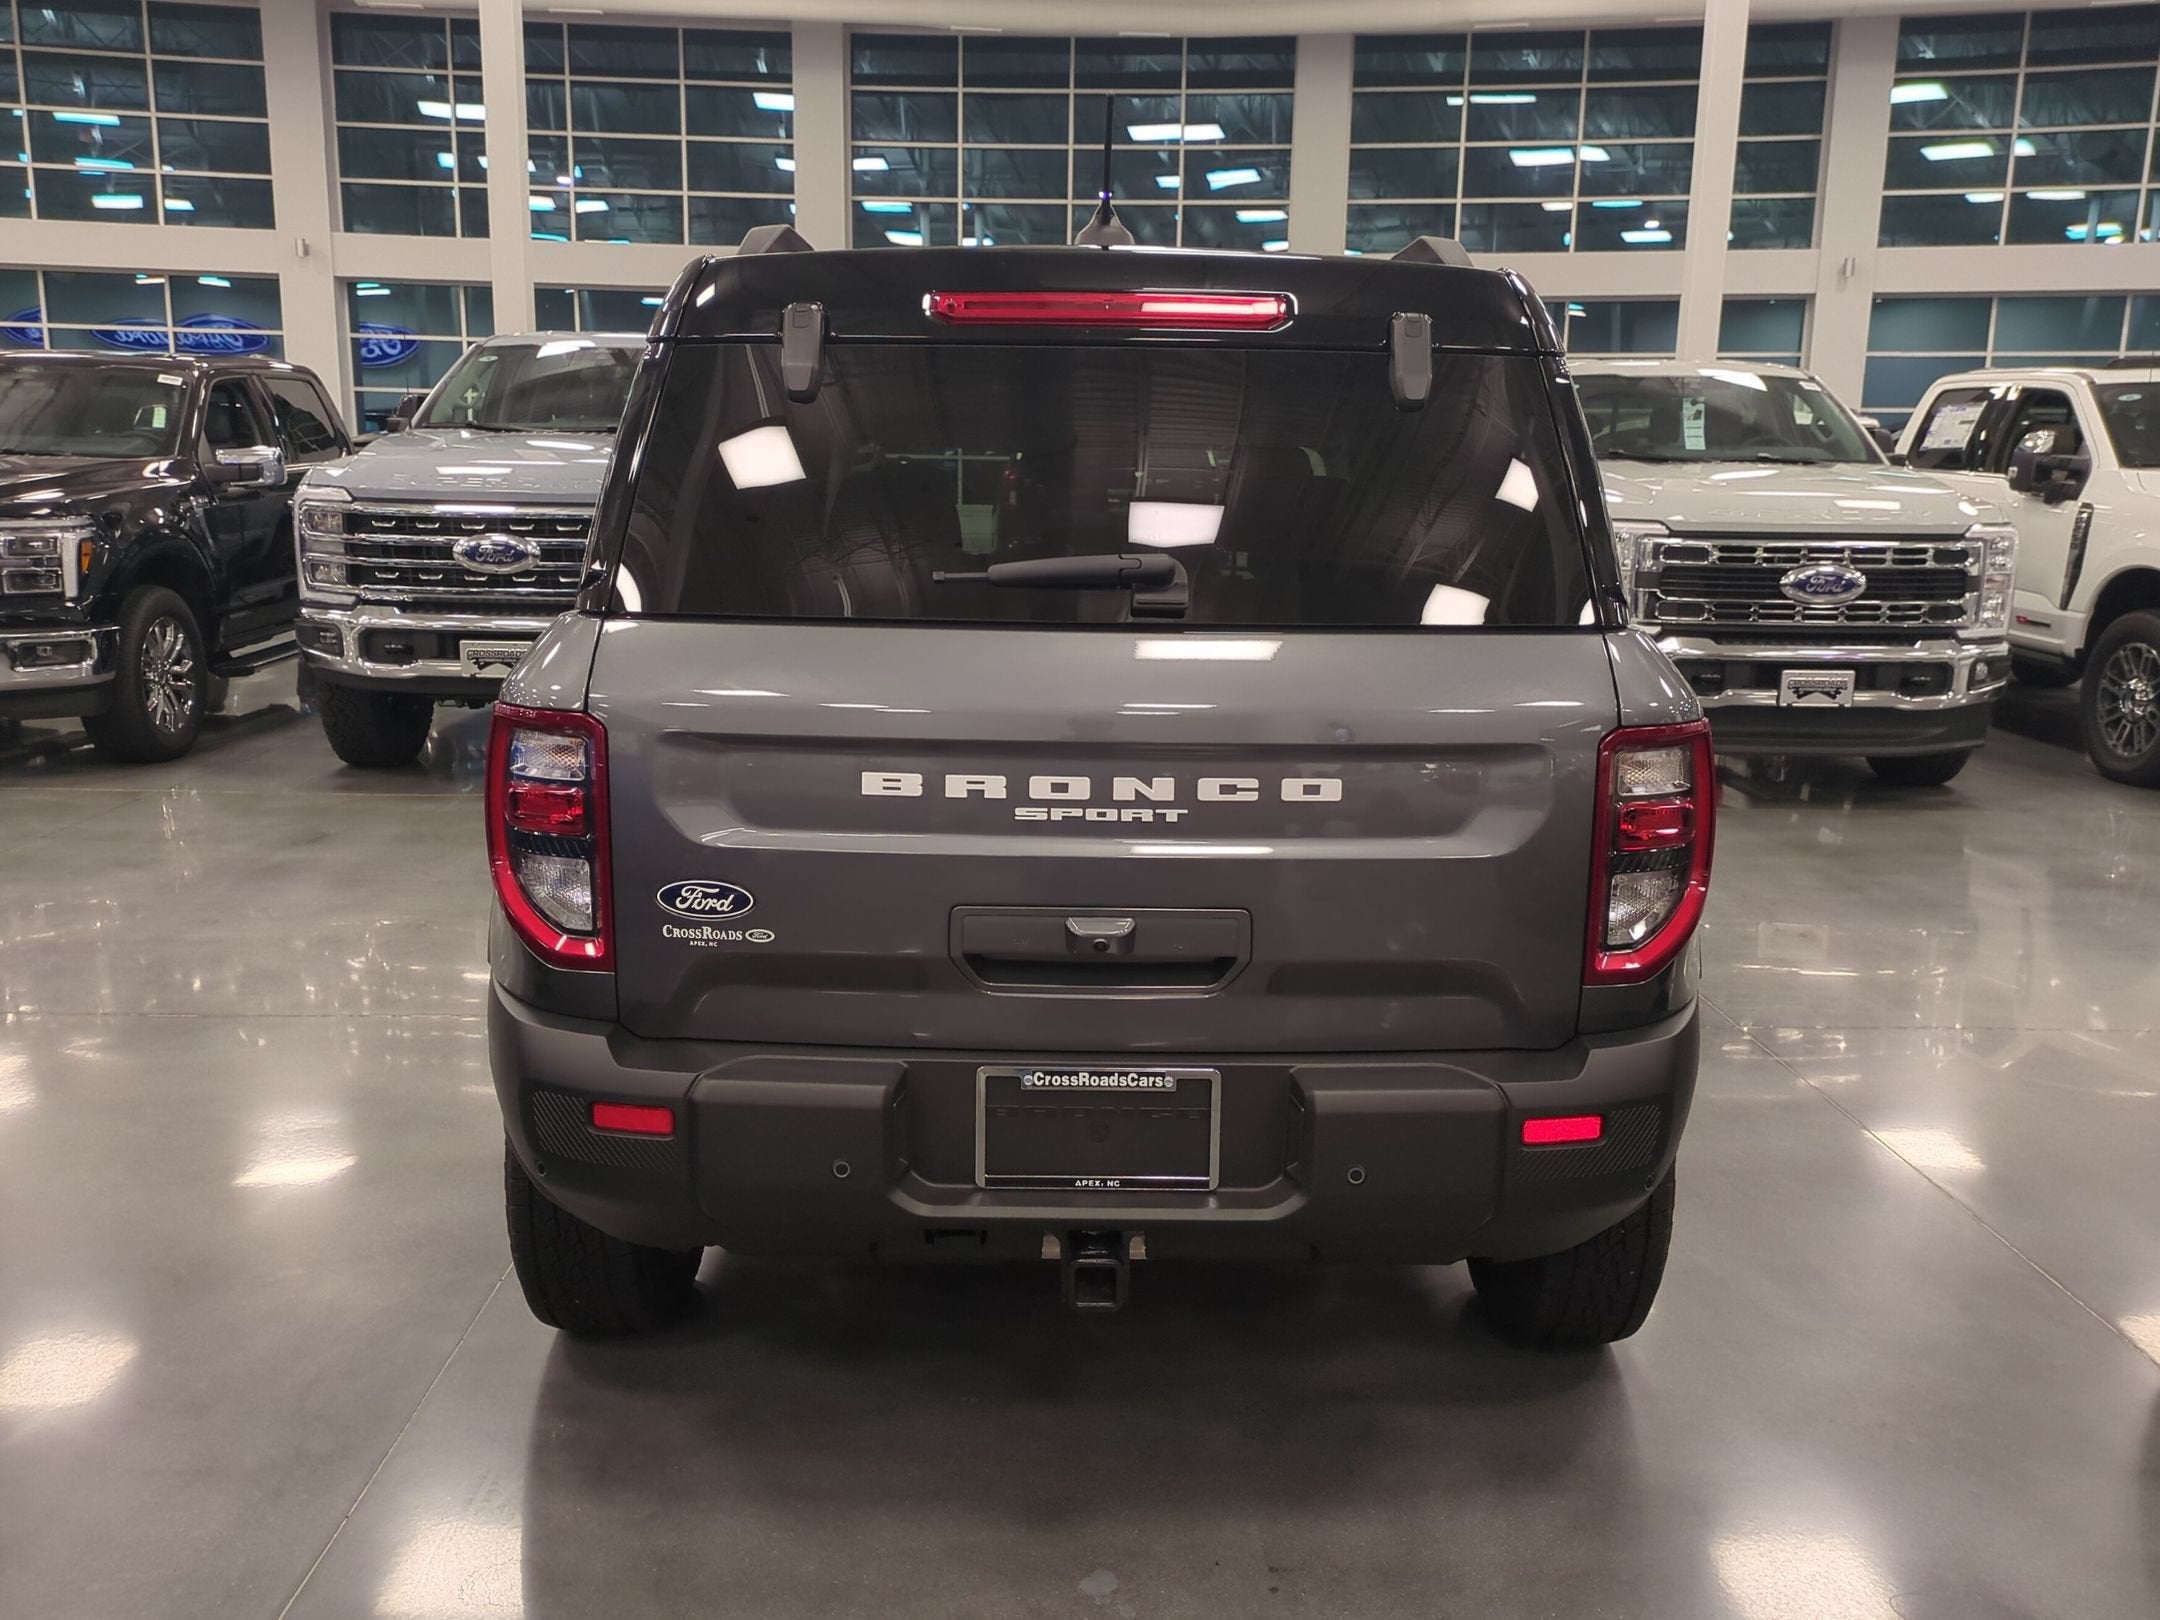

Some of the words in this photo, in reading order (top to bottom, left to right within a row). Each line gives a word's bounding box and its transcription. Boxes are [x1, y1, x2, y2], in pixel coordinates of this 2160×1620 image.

[475, 545, 515, 562] Ford
[1806, 575, 1846, 593] Ford
[861, 771, 1343, 802] BRONCO
[1014, 807, 1189, 823] SPORT
[675, 885, 735, 912] Ford
[1033, 1071, 1164, 1088] CrossRoadsCars
[1107, 1180, 1120, 1188] NC
